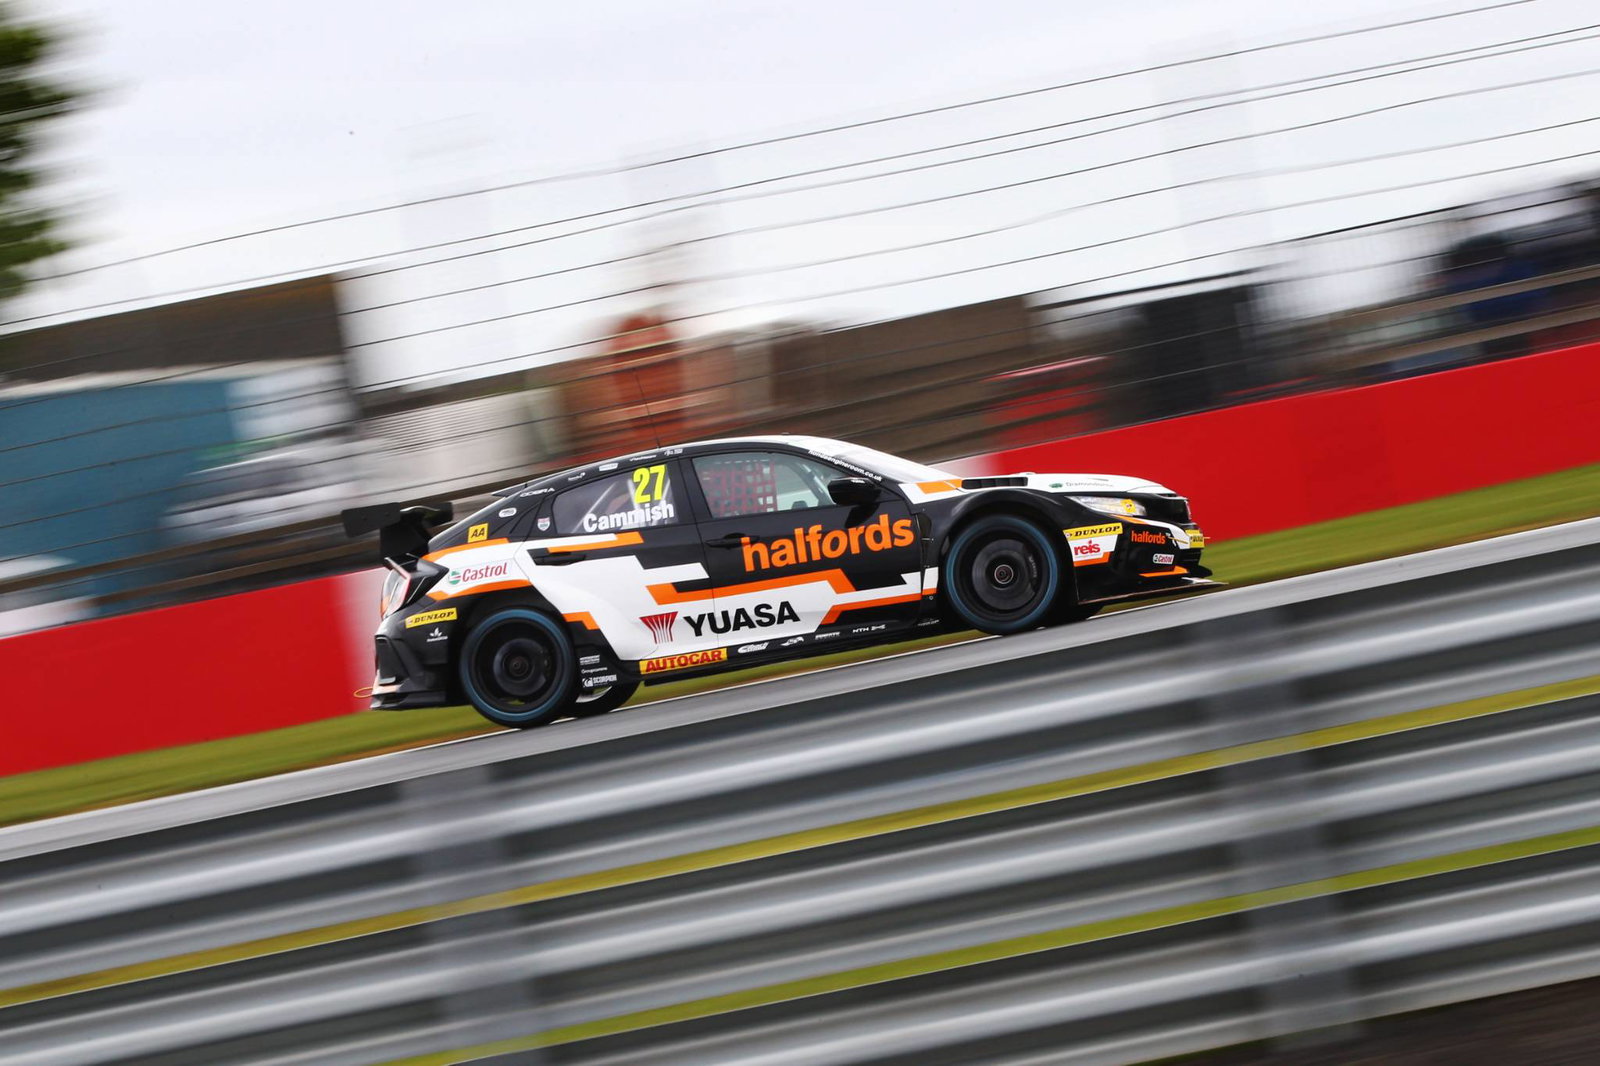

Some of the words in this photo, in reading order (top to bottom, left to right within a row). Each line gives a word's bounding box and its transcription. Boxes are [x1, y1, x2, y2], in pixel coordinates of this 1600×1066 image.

[519, 487, 555, 498] COBRA
[632, 464, 667, 504] 27
[583, 502, 675, 533] Cammish
[470, 526, 485, 539] AA
[1074, 525, 1121, 537] DUNLOP
[1131, 530, 1166, 546] halfords
[740, 513, 915, 573] halfords
[1074, 540, 1101, 556] reis
[462, 562, 508, 583] Castrol
[414, 610, 455, 625] DUNLOP
[683, 600, 801, 637] YUASA
[645, 651, 722, 673] AUTOCAR
